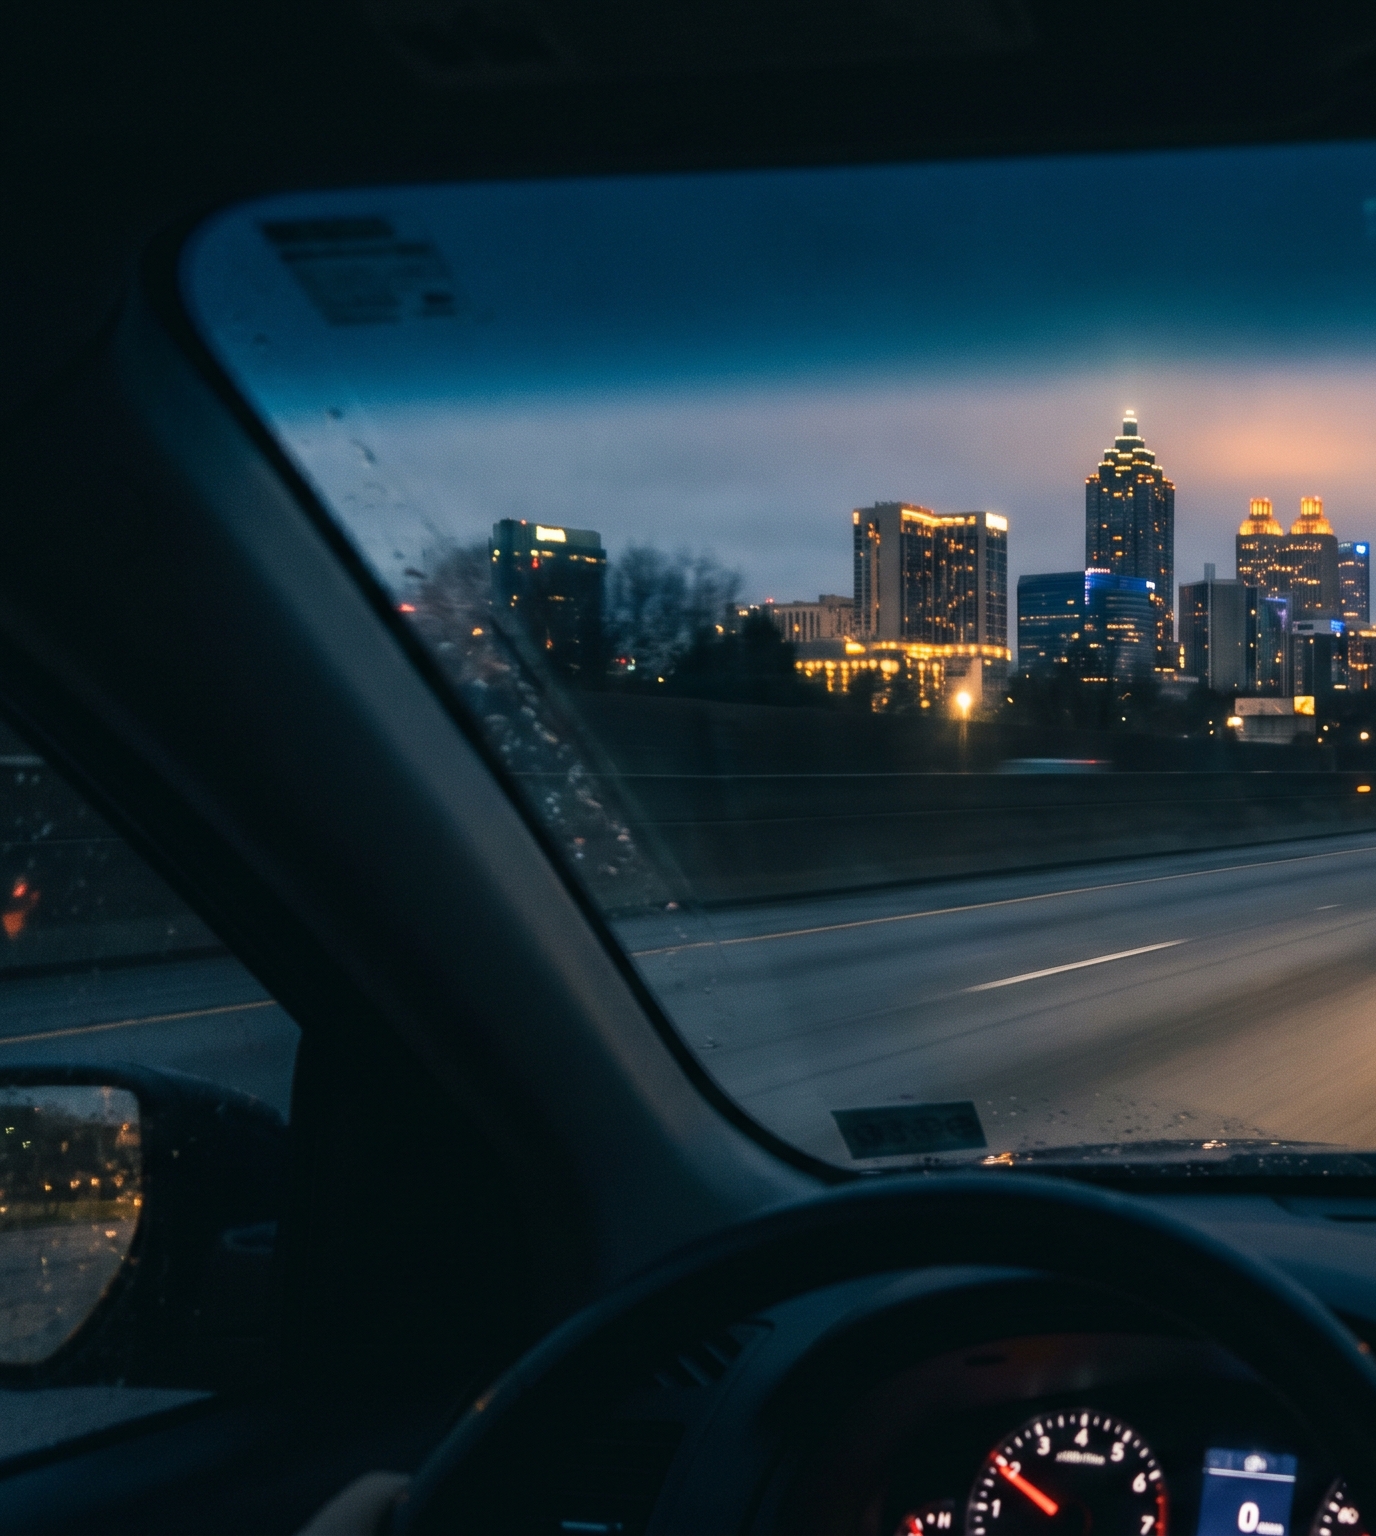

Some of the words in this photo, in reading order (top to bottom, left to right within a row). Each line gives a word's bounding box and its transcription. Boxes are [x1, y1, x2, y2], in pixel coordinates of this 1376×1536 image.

[1036, 1436, 1050, 1456] 3
[1074, 1428, 1088, 1447] 4
[1110, 1442, 1124, 1462] 5
[1132, 1472, 1146, 1493] 6
[991, 1499, 1001, 1518] 1
[1237, 1501, 1260, 1533] 0
[1140, 1515, 1155, 1535] 7
